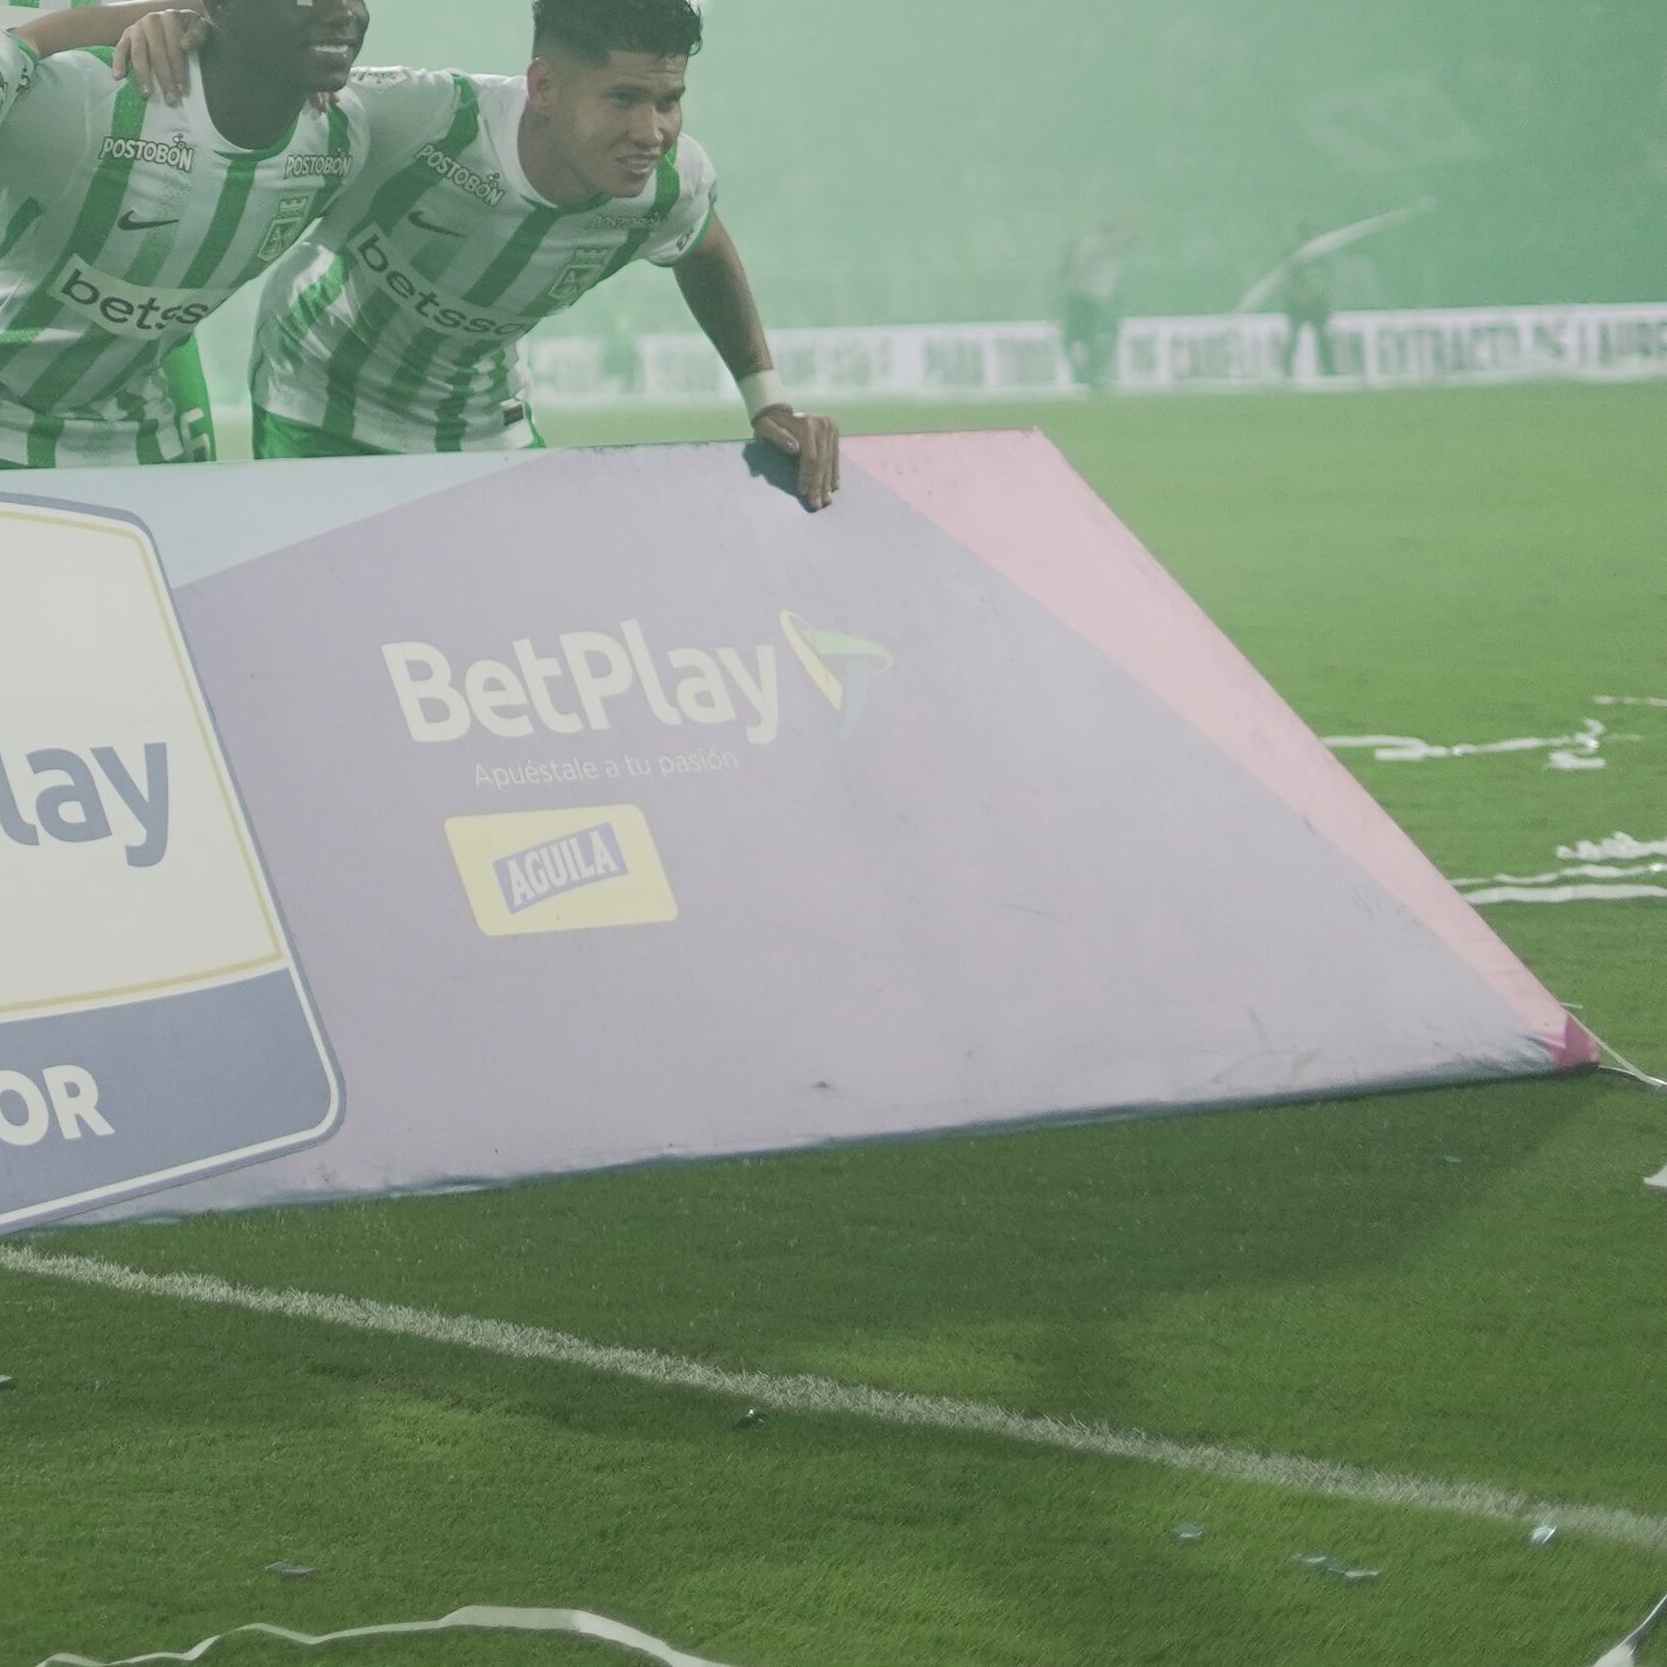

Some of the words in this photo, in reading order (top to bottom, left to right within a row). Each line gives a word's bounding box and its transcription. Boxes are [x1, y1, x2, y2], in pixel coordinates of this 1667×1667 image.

[381, 618, 779, 745] BetPlay
[474, 757, 598, 790] Apuéstale
[605, 760, 620, 778] a
[625, 755, 652, 776] tu
[661, 747, 739, 783] pasión
